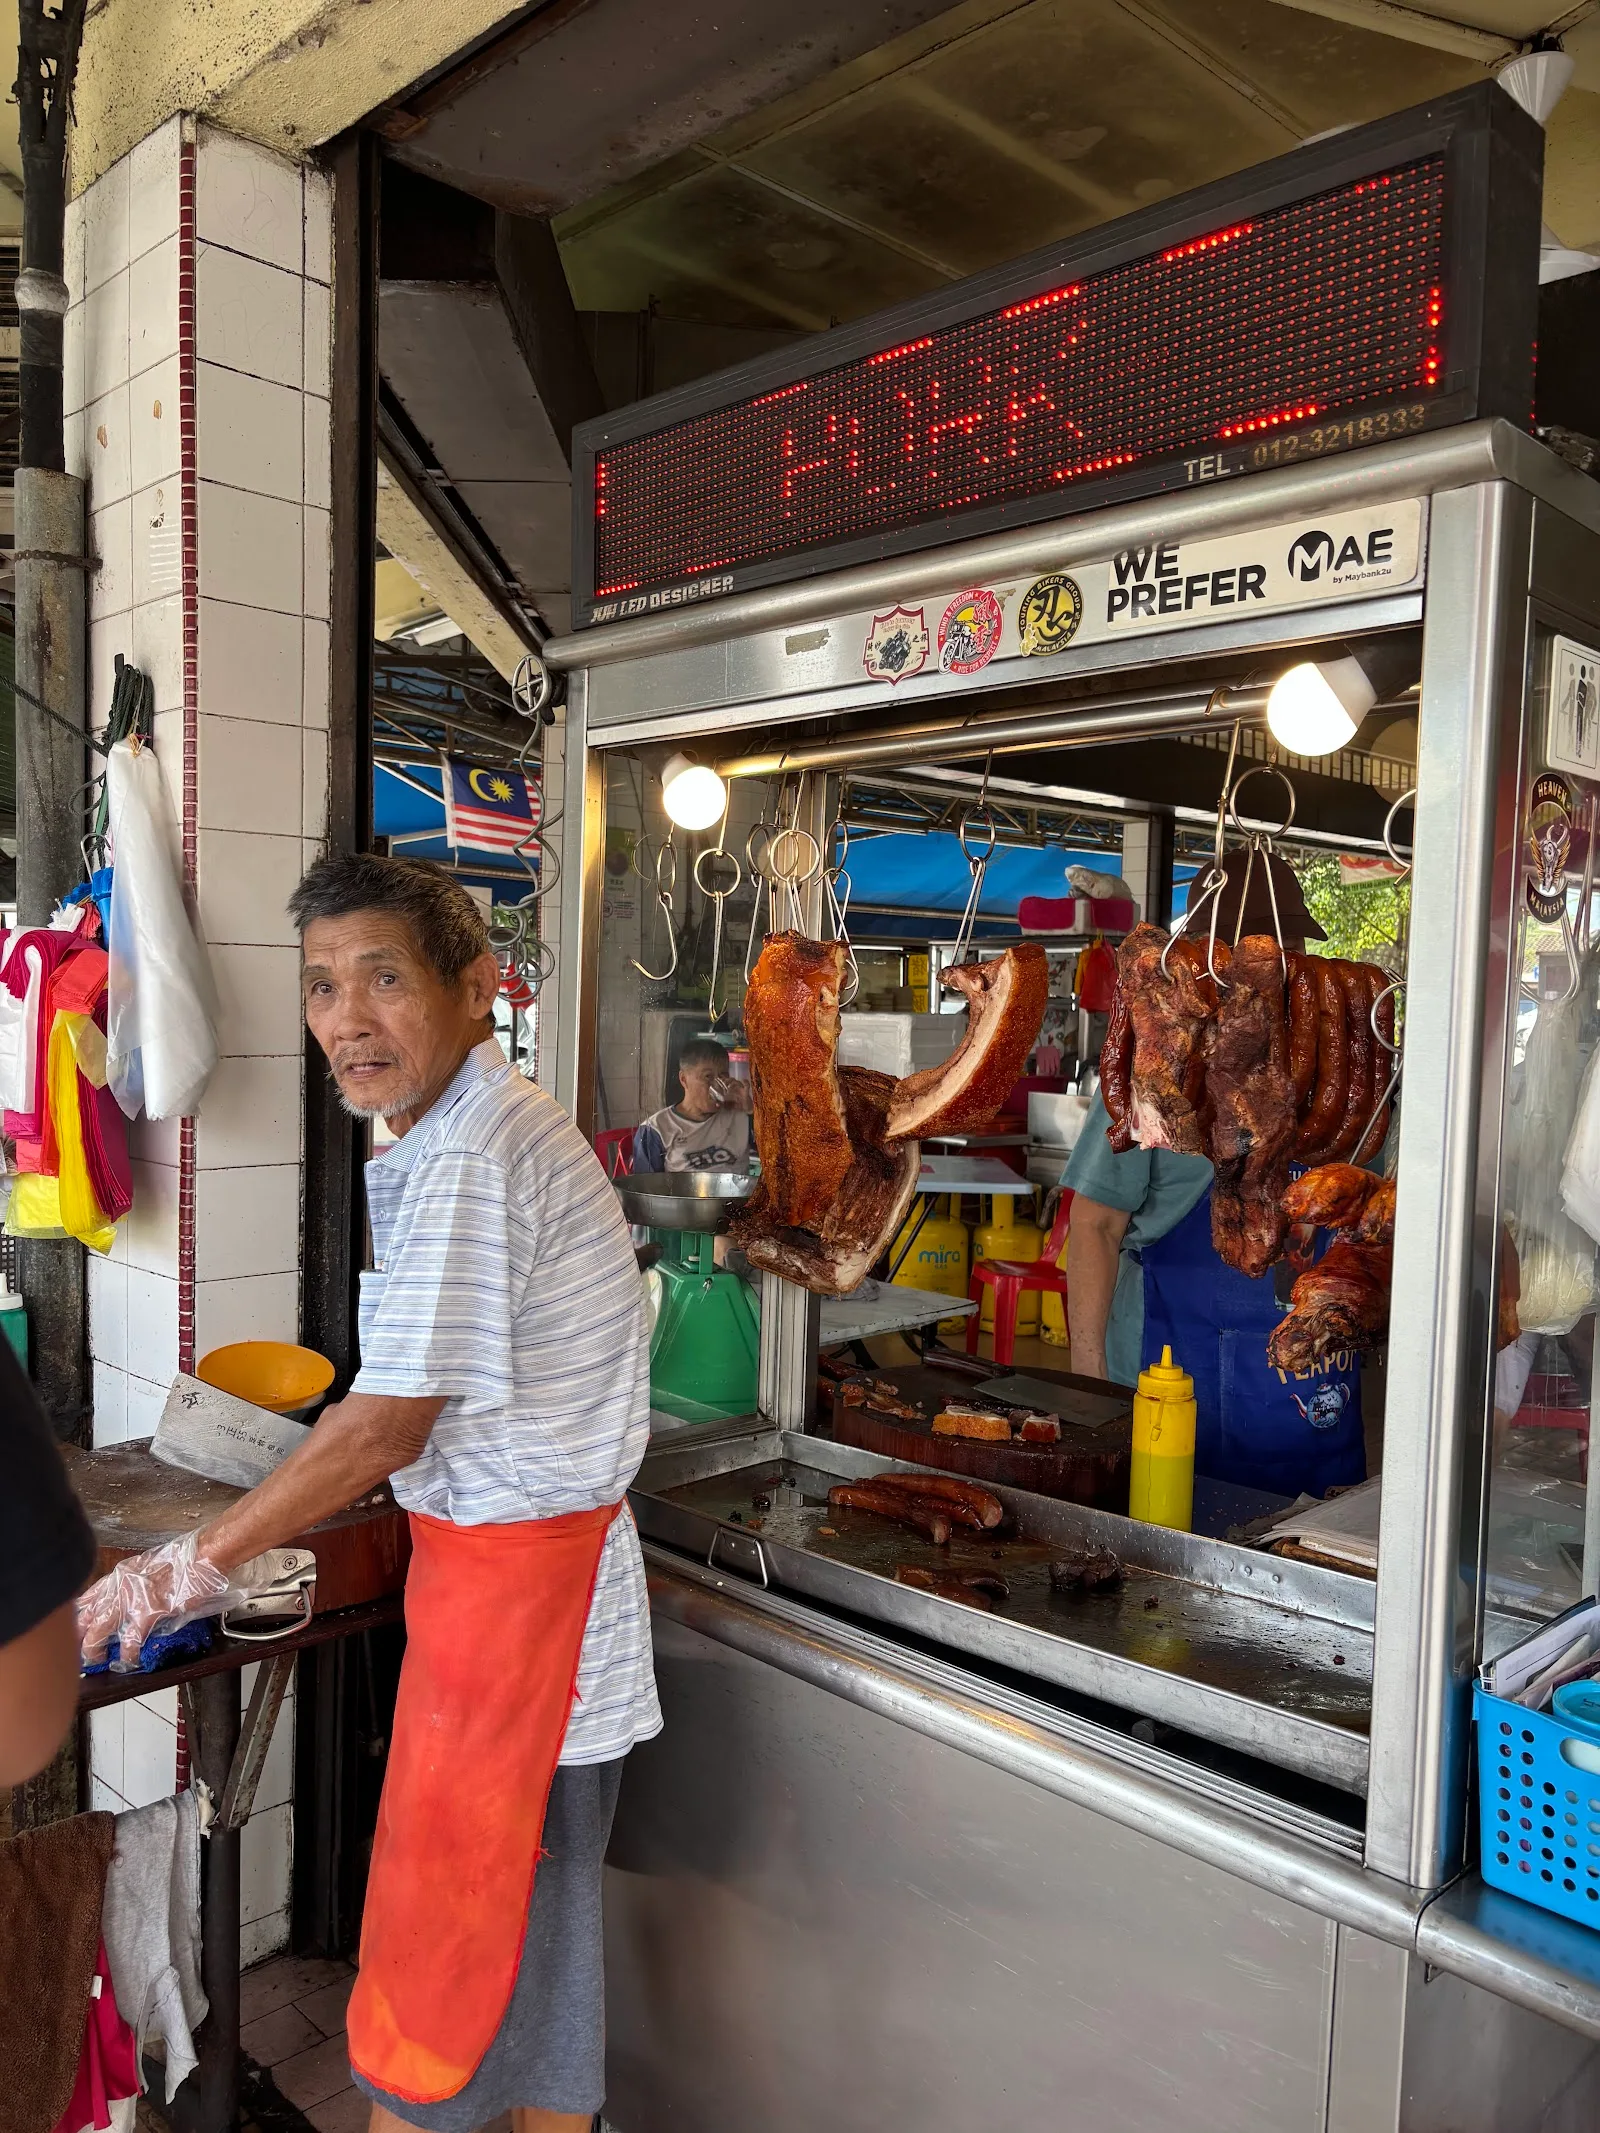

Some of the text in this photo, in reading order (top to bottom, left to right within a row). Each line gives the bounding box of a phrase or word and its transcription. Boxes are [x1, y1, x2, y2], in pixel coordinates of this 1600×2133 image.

[1252, 403, 1426, 467] 012-3218333
[1113, 542, 1180, 585] WE
[1287, 528, 1395, 582] MAE
[1344, 567, 1392, 582] Maybank2u
[619, 596, 648, 616] LED
[1020, 589, 1036, 630] TOURING
[1036, 576, 1065, 590] BIKERS
[1065, 581, 1081, 609] GROUP
[1107, 564, 1267, 623] PREFER
[939, 616, 949, 636] WIND
[950, 592, 974, 612] FREEDOM
[957, 641, 998, 674] RIDE FOR RESPECT
[1035, 632, 1072, 652] MALAYSIA
[1537, 781, 1568, 805] HEAVEN
[1529, 892, 1565, 918] MALAYSIA
[918, 1244, 960, 1263] mira
